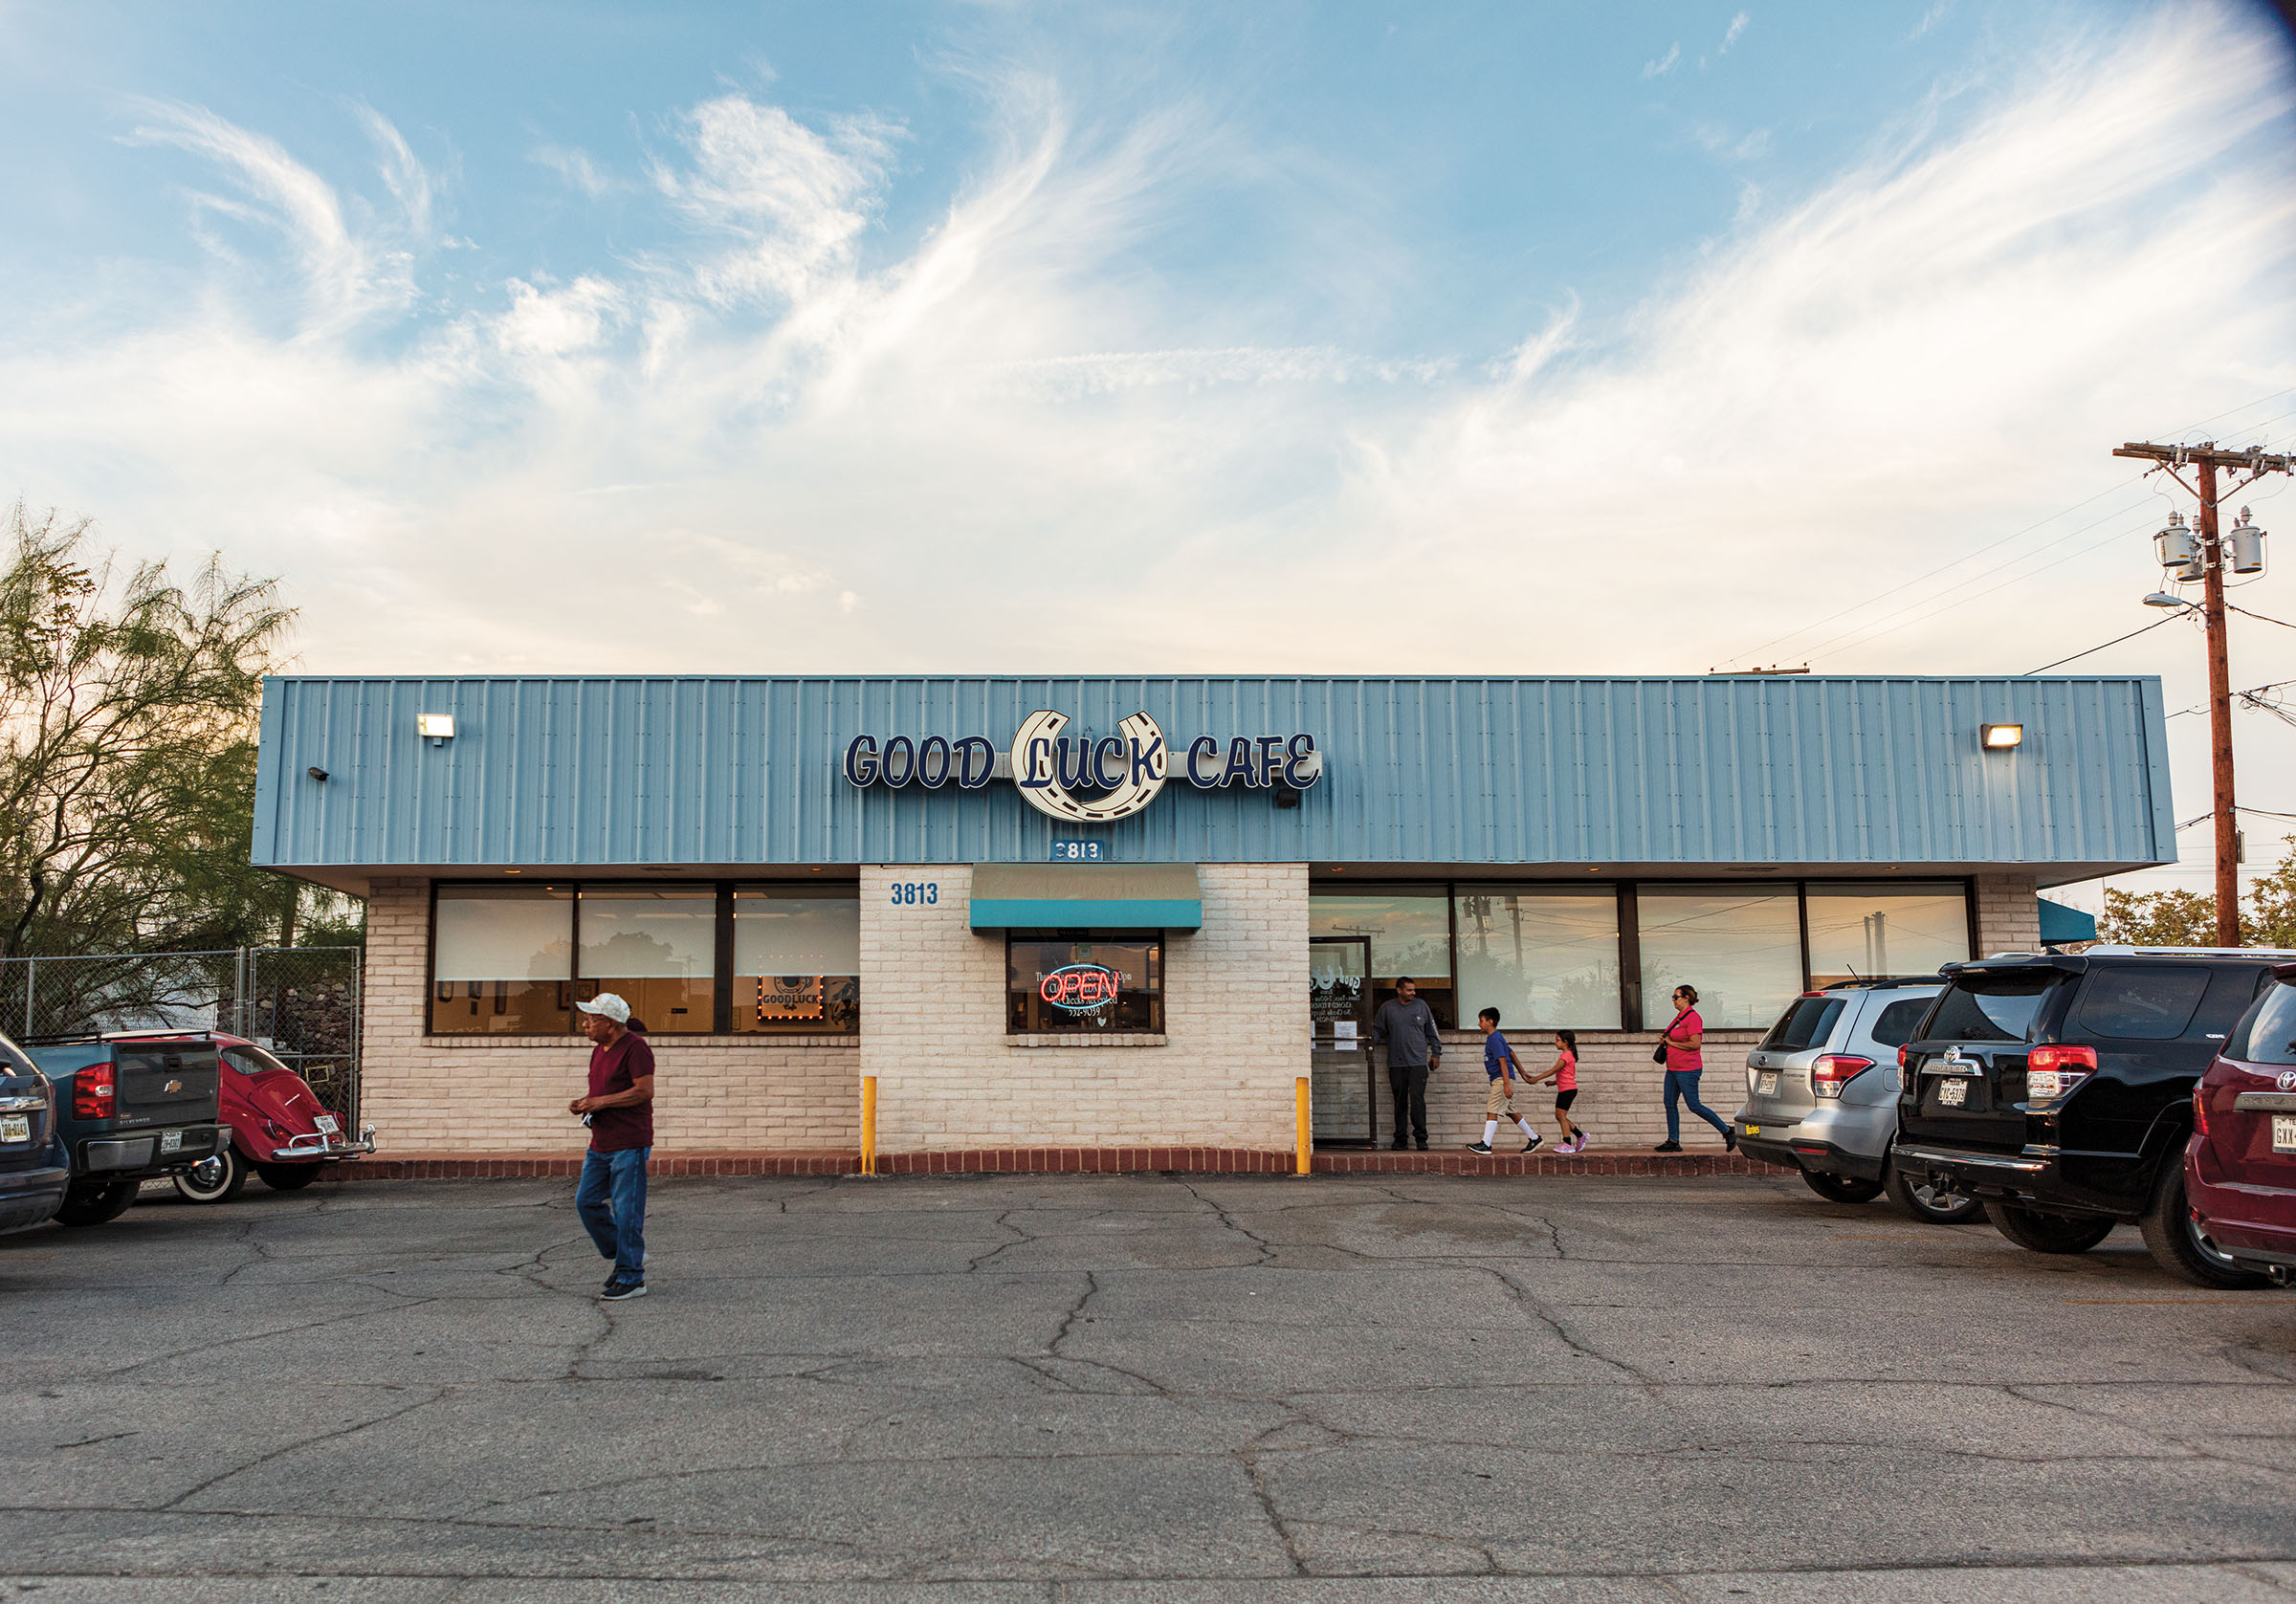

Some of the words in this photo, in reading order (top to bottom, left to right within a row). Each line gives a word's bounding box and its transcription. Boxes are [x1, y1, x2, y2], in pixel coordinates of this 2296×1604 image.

[846, 735, 996, 788] GOOD
[1019, 736, 1165, 789] LUCK
[1186, 734, 1319, 789] CAFE
[1055, 842, 1098, 859] 3813
[891, 882, 938, 905] 3813
[1041, 972, 1118, 1001] OPEN
